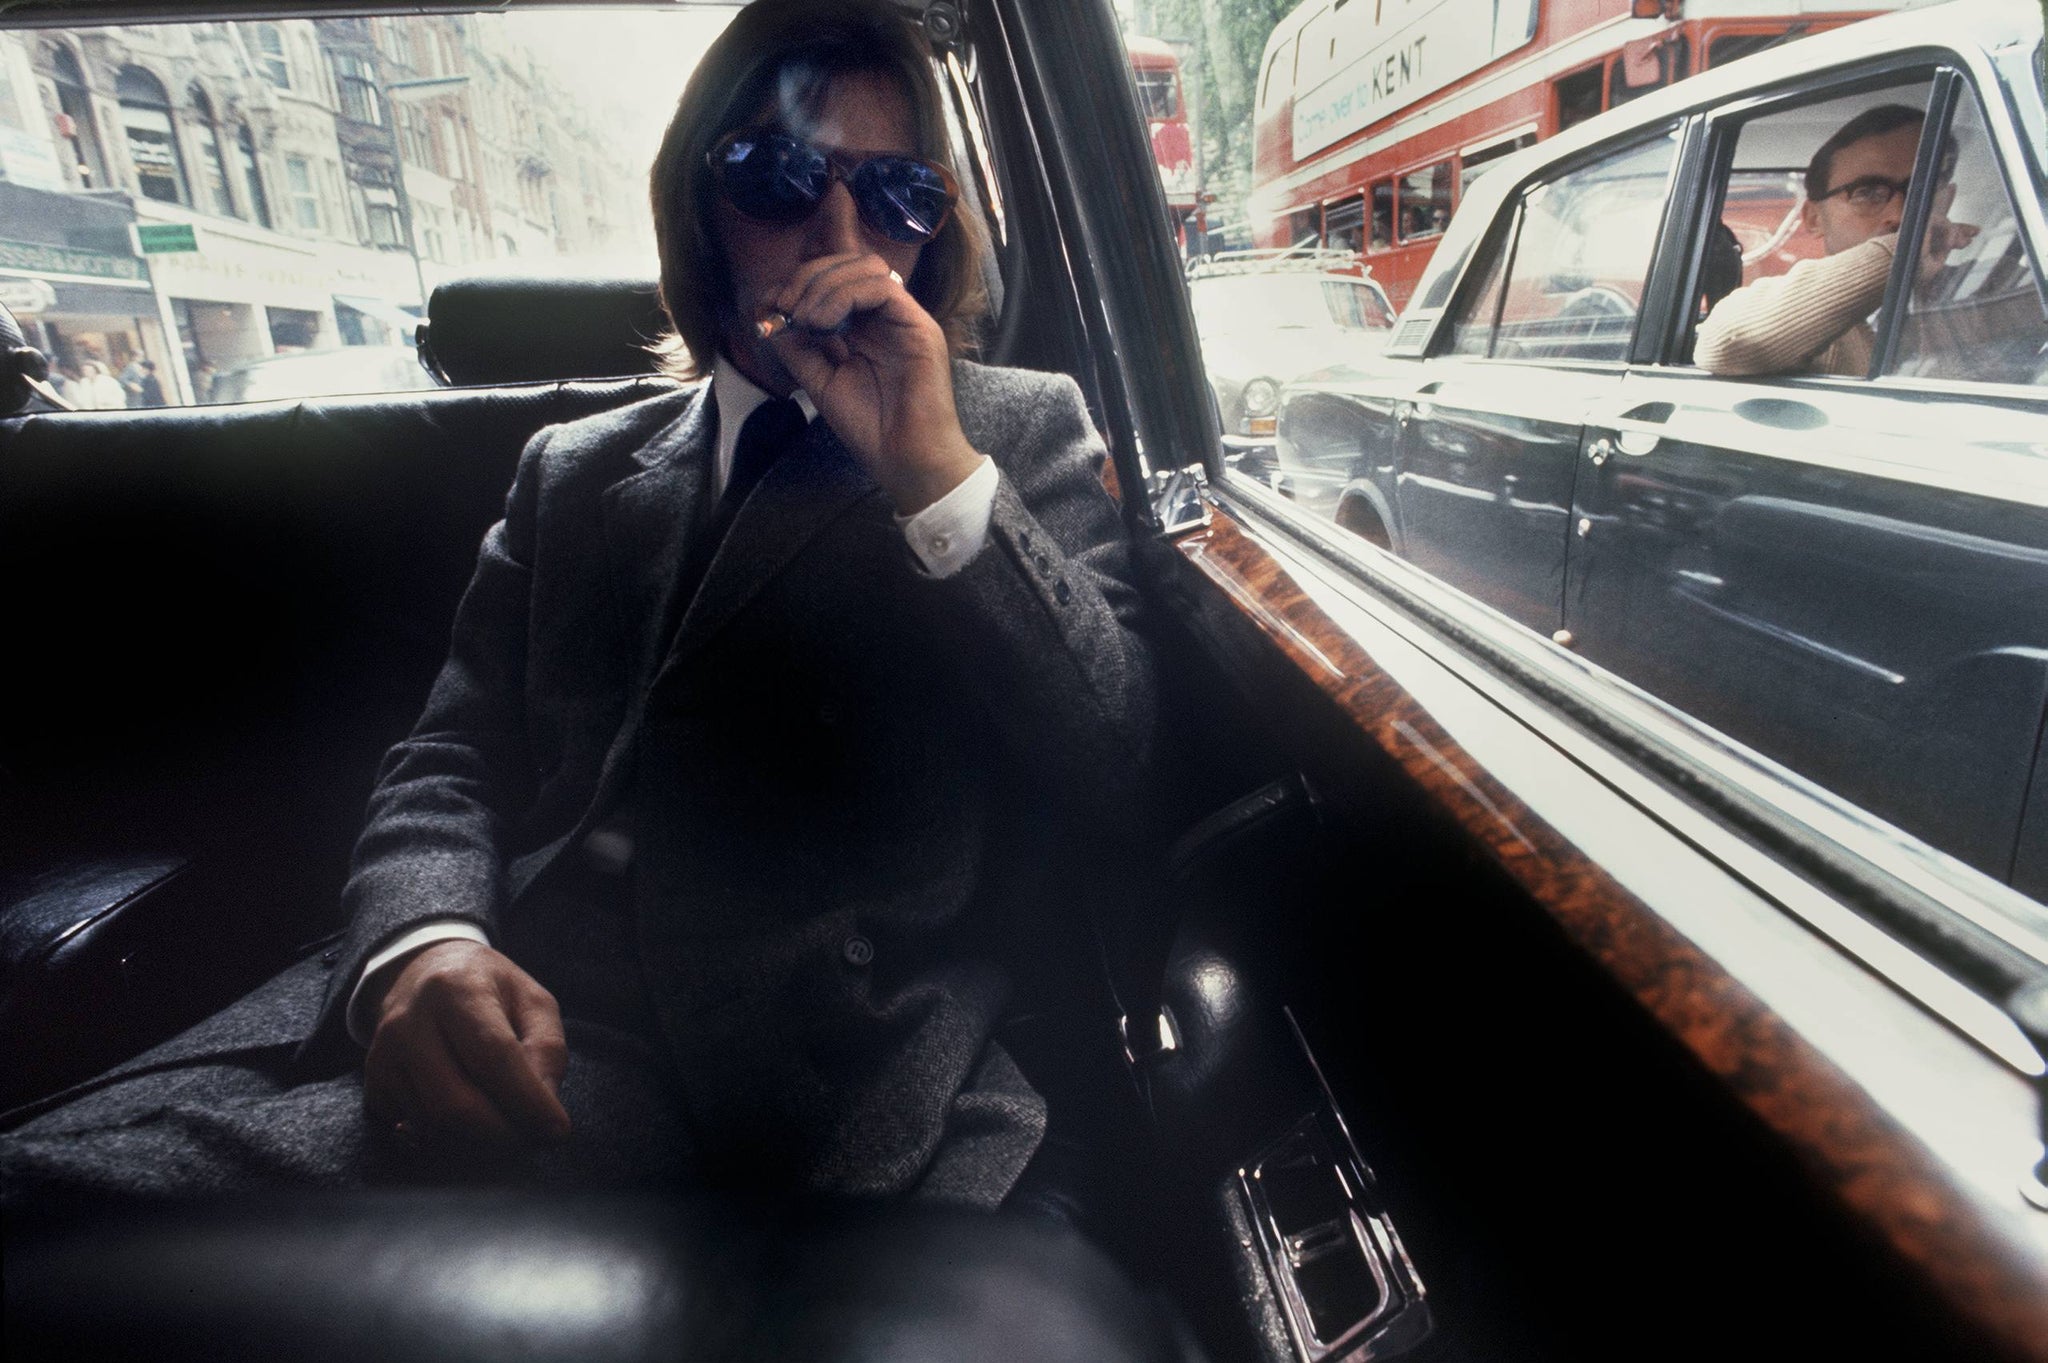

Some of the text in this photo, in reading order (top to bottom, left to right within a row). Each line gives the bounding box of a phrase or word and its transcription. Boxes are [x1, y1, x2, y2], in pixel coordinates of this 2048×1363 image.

[1330, 91, 1353, 124] over
[1356, 83, 1369, 109] to
[1372, 36, 1427, 104] KENT
